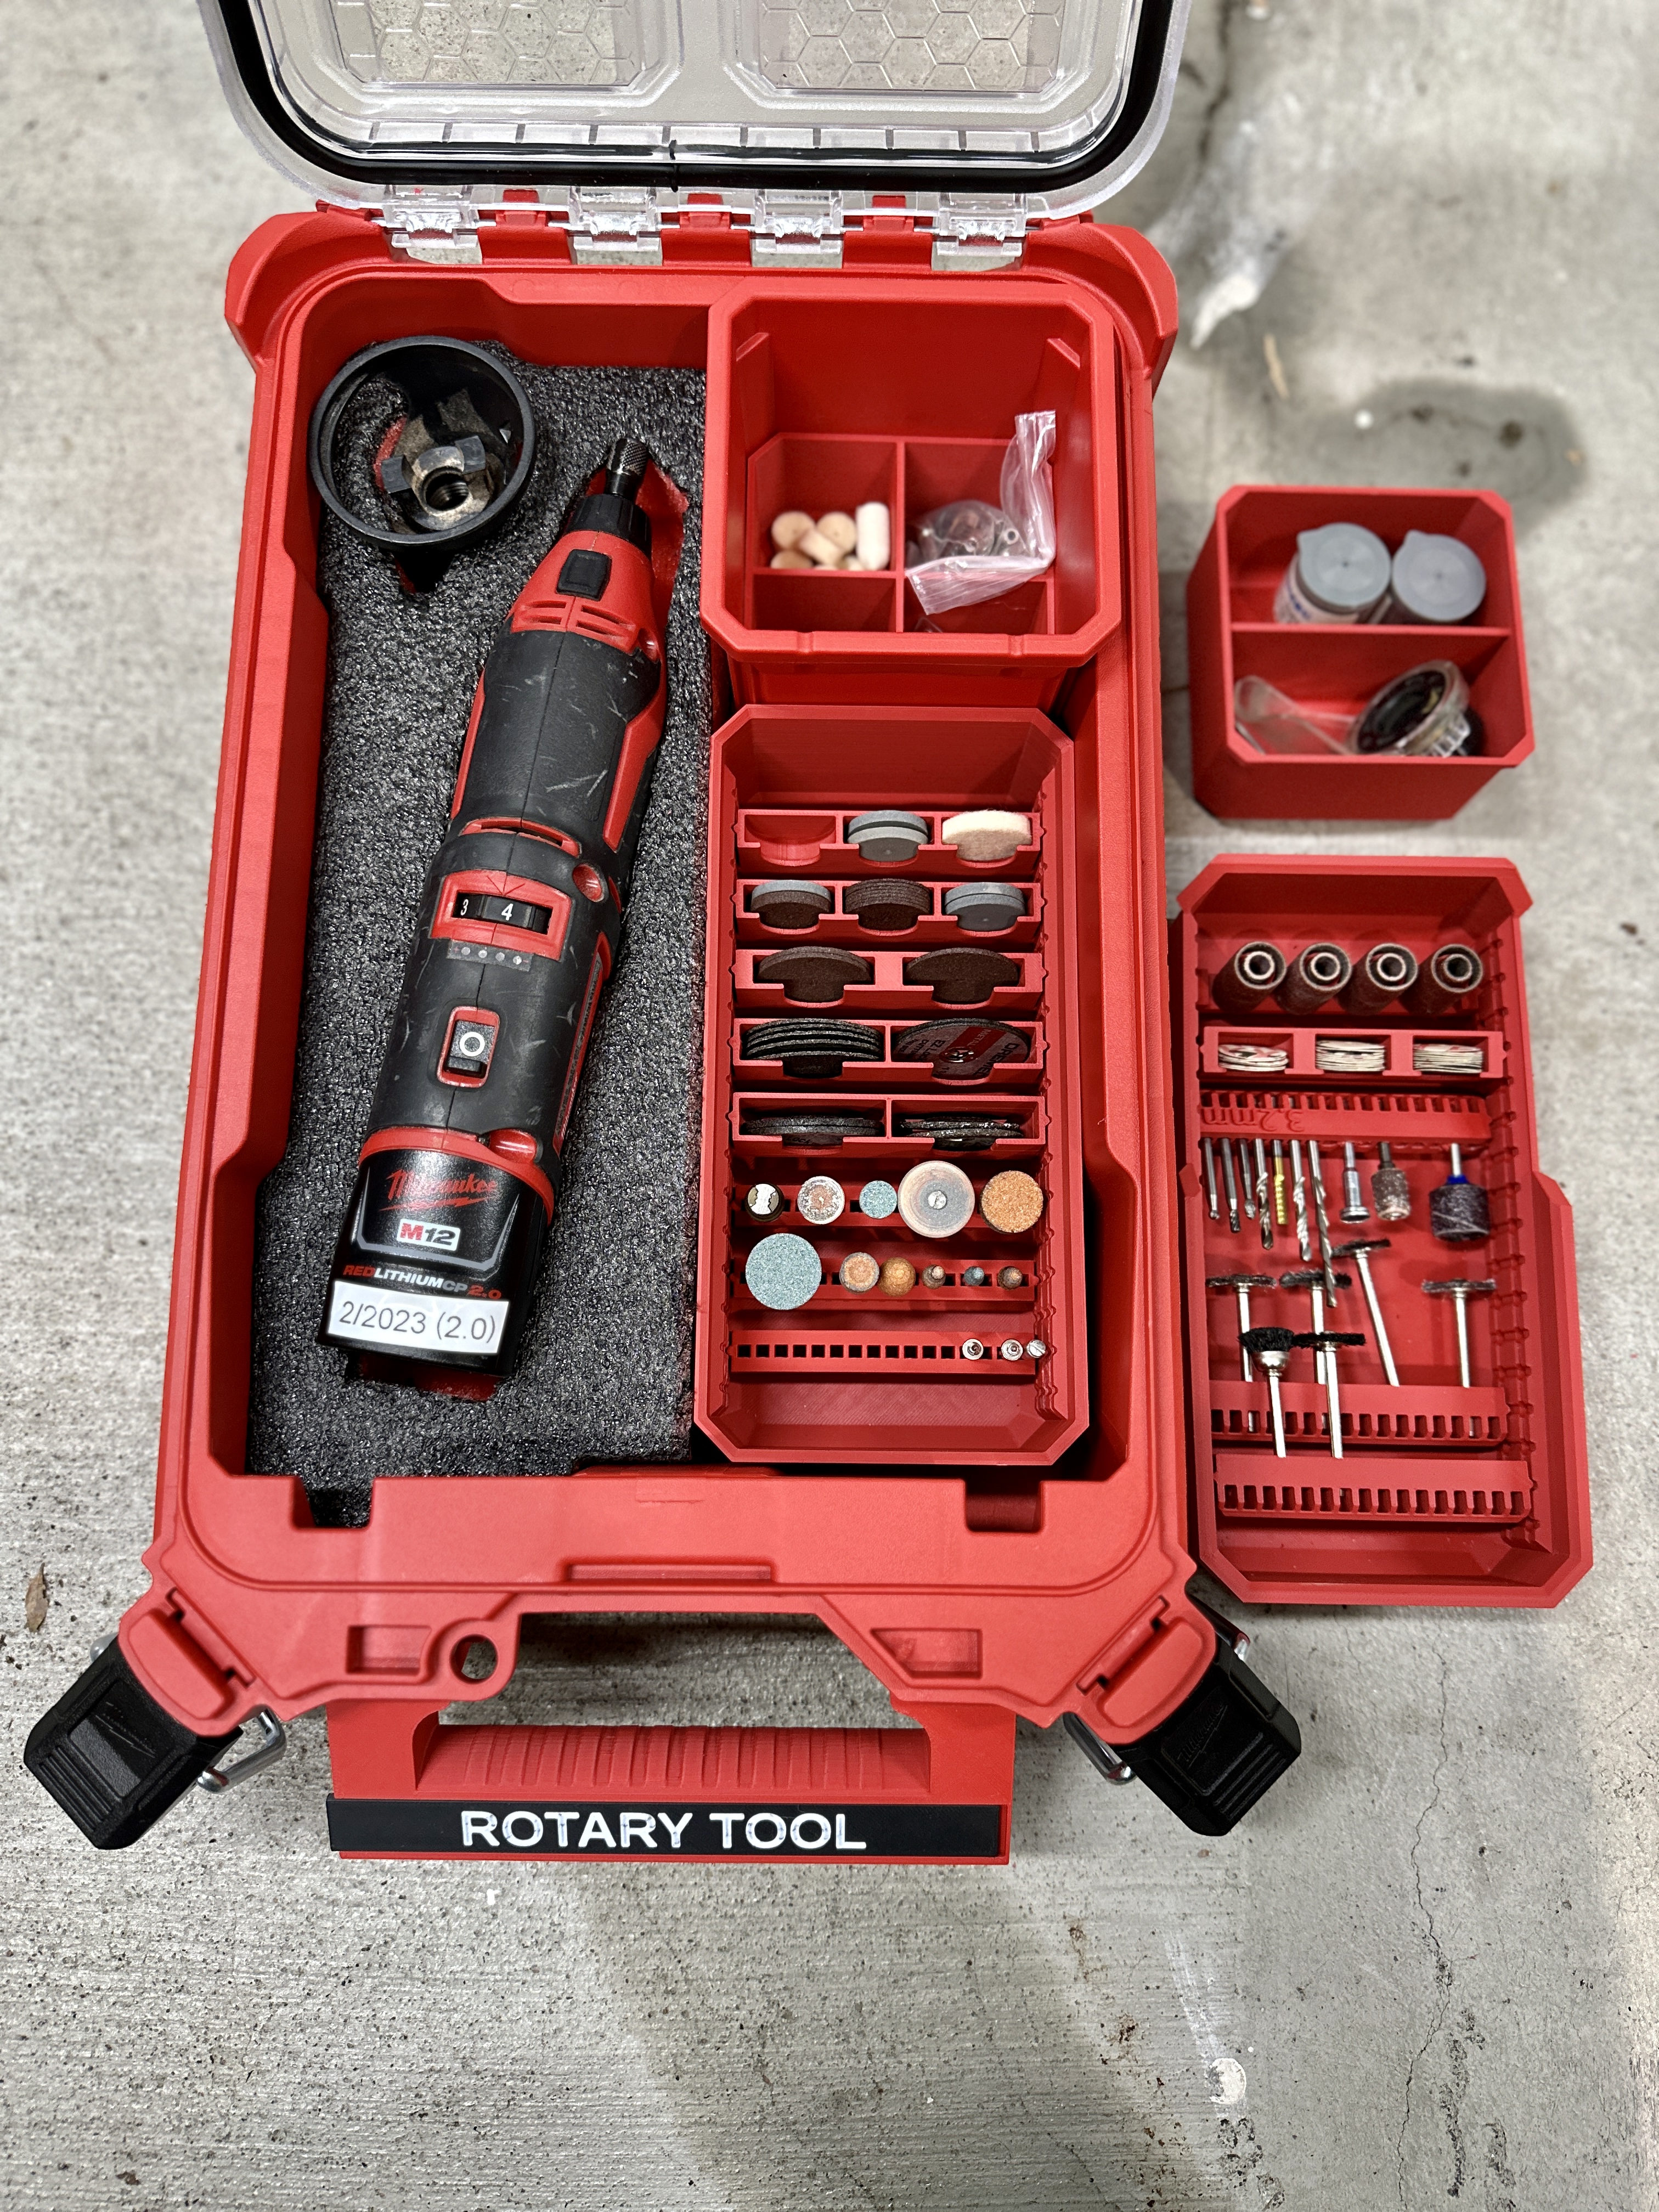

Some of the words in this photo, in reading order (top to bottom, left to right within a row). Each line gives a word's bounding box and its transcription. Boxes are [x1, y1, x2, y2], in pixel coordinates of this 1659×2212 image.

[460, 899, 469, 916] 3
[501, 903, 514, 921] 4
[972, 1042, 1020, 1076] DREMEL
[386, 1168, 498, 1200] Maukee
[400, 1222, 456, 1246] M12
[467, 1284, 501, 1300] 2.0
[339, 1300, 426, 1334] 2/2023
[437, 1312, 495, 1344] (2.0)
[461, 1810, 693, 1848] ROTARY
[709, 1813, 867, 1849] TOOL
